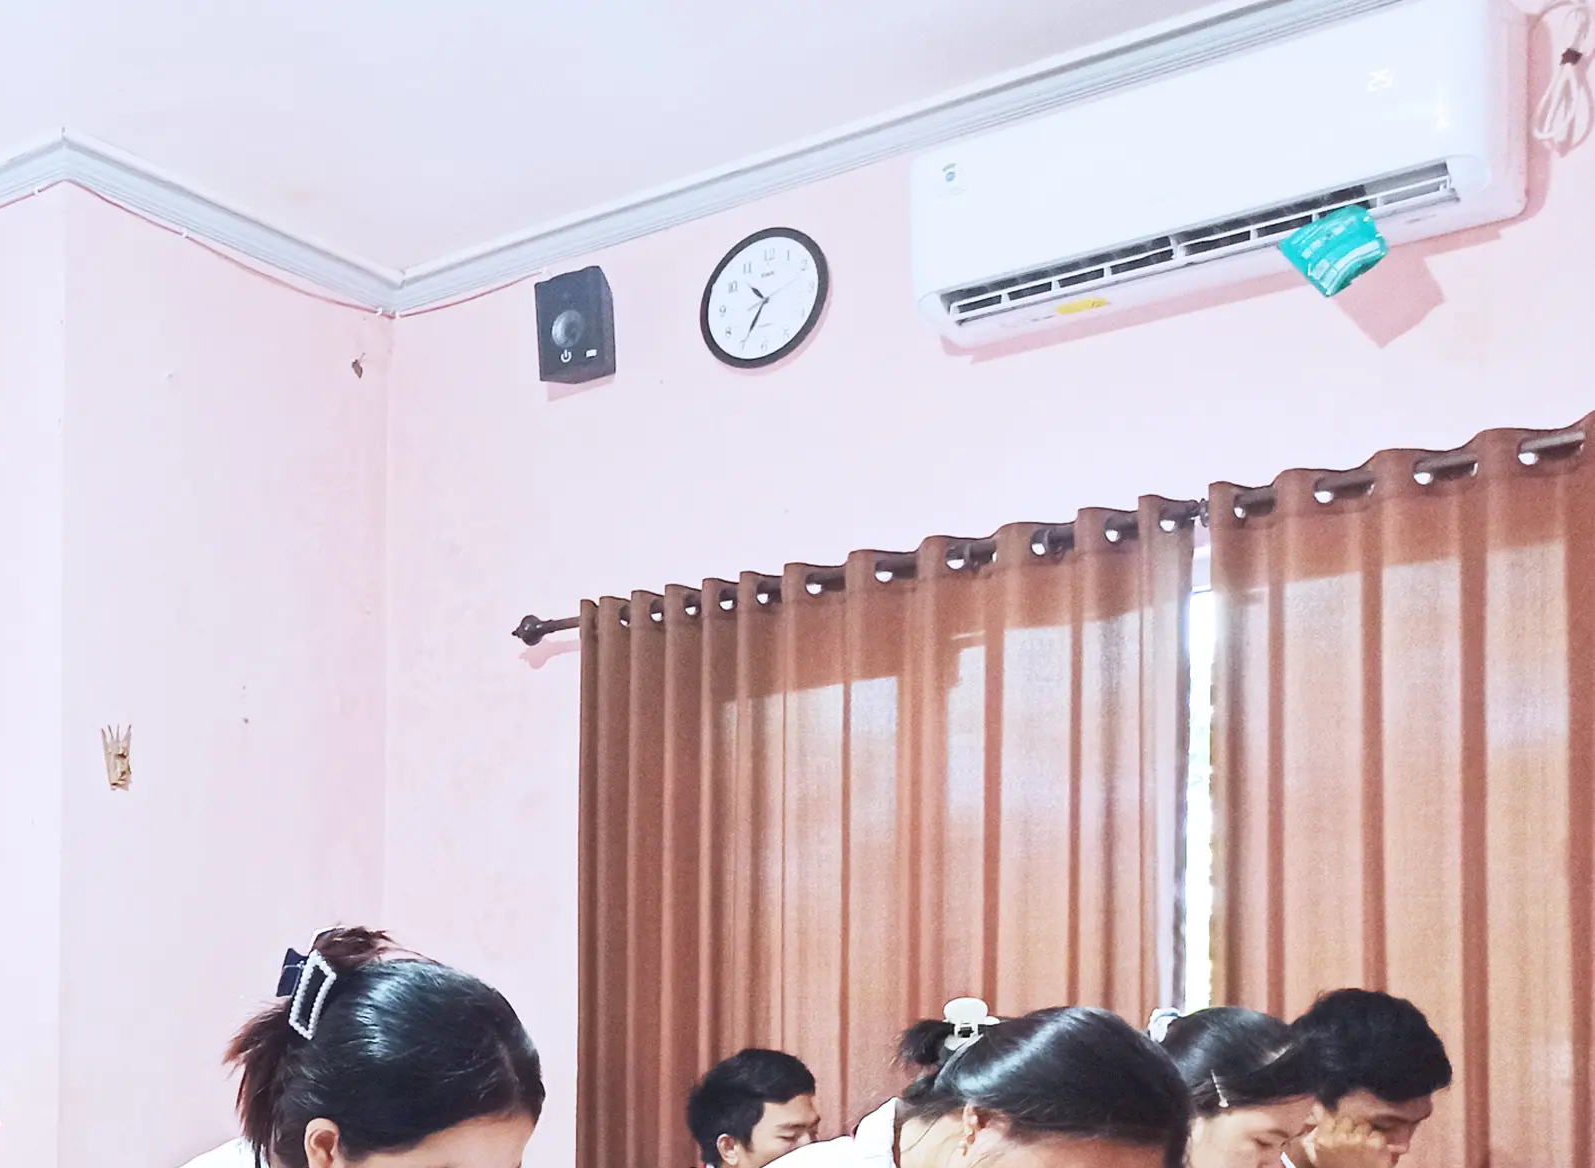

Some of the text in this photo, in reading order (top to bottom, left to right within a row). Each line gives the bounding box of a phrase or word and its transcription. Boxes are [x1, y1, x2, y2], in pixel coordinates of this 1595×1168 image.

[764, 248, 776, 260] 12
[786, 249, 791, 261] 1
[743, 261, 752, 274] 11
[801, 259, 809, 272] 2
[728, 280, 738, 293] 10
[719, 305, 727, 317] 9
[724, 327, 732, 338] 8
[740, 340, 747, 351] 7
[761, 338, 769, 351] 6
